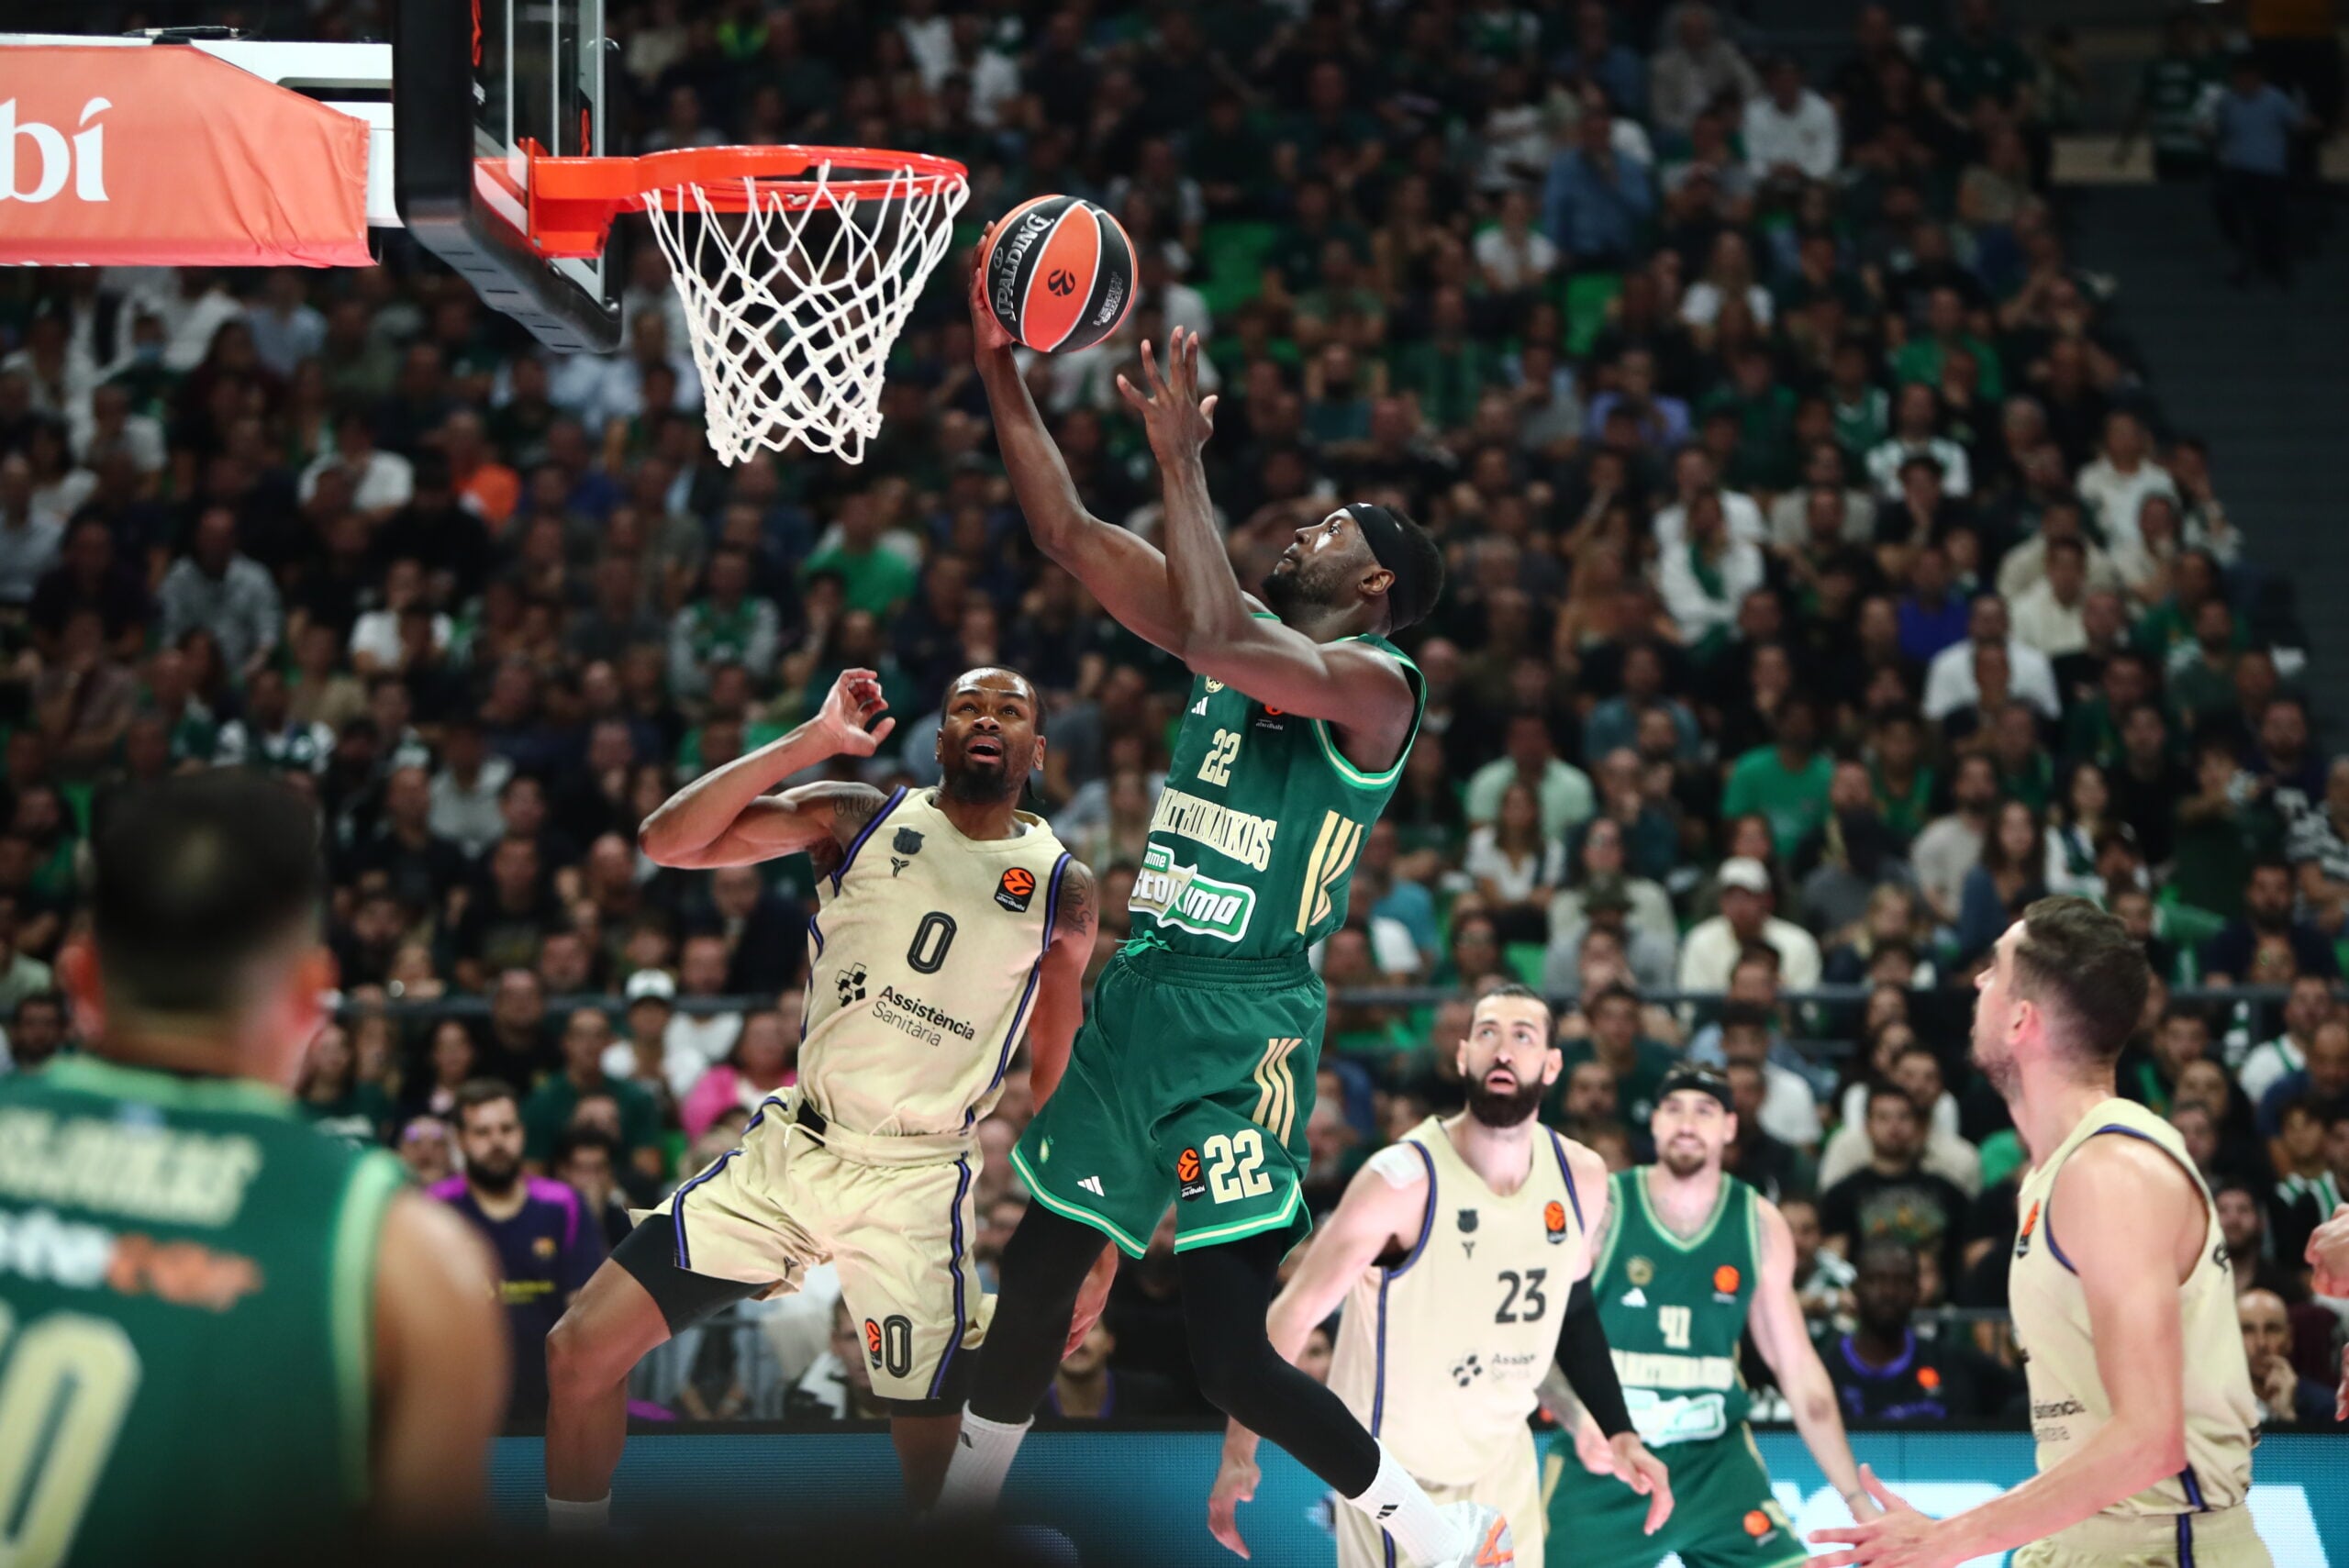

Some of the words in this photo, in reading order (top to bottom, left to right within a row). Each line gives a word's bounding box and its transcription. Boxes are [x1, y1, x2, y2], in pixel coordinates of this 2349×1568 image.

[996, 213, 1052, 322] SPALDING
[1197, 728, 1241, 788] 22
[907, 911, 957, 974] 0
[873, 1001, 941, 1047] Sanitària
[879, 985, 975, 1040] Assistència
[1204, 1129, 1273, 1205] 22
[1495, 1268, 1547, 1324] 23
[884, 1315, 912, 1378] 0
